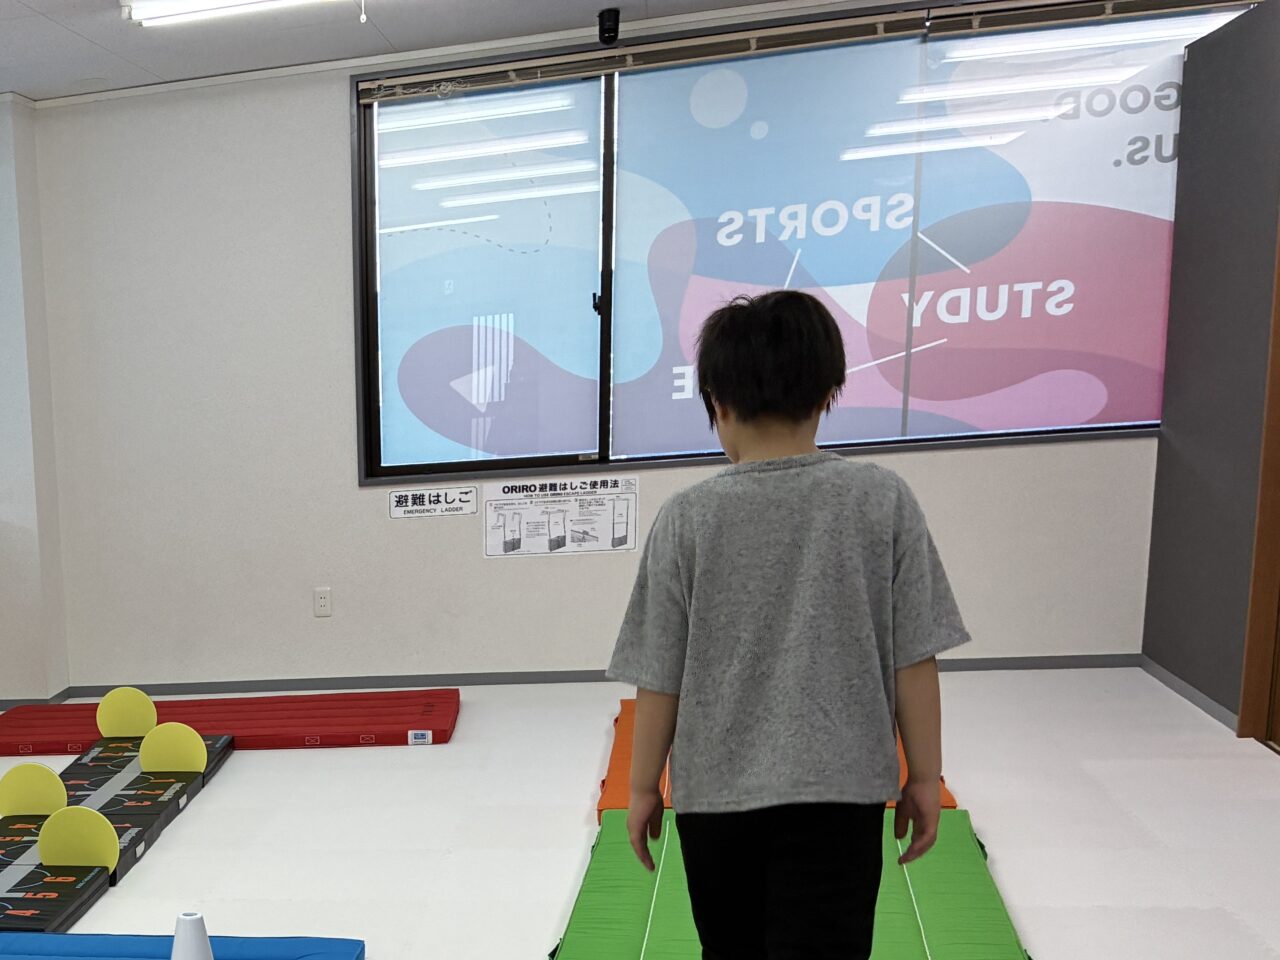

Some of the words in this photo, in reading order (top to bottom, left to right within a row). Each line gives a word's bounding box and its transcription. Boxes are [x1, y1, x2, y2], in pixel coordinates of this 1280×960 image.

[502, 484, 537, 494] ORIRO
[394, 490, 472, 508] 避難はしご
